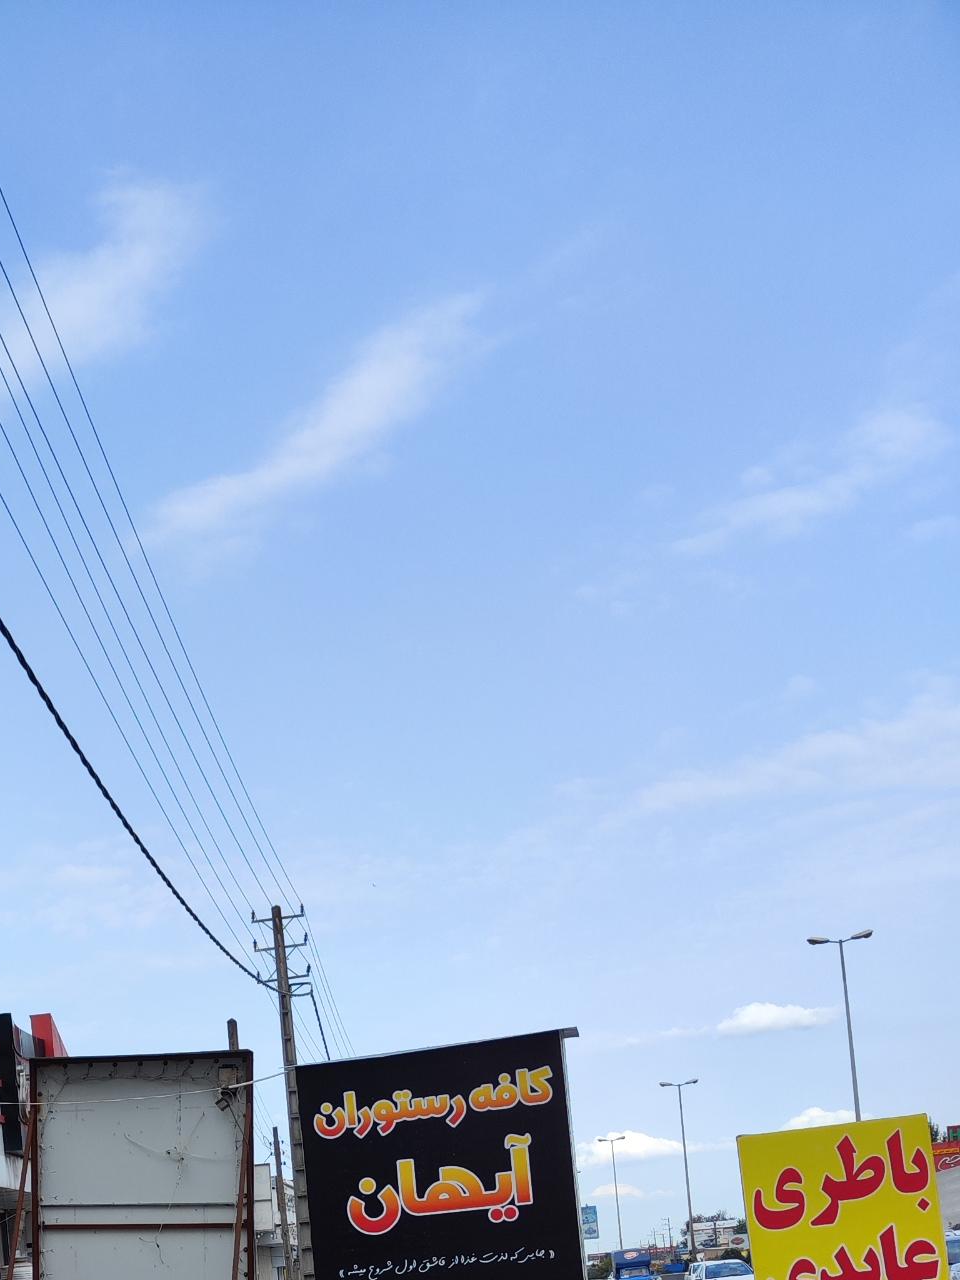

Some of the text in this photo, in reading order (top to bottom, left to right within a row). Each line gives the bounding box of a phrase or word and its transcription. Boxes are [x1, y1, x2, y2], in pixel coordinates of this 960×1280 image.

[313, 1065, 553, 1139] کافه رستوران
[347, 1132, 534, 1235] آیهان
[753, 1128, 931, 1231] باطری
[368, 1260, 393, 1280] شروع
[395, 1258, 417, 1275] اول
[418, 1256, 446, 1273] قاشق
